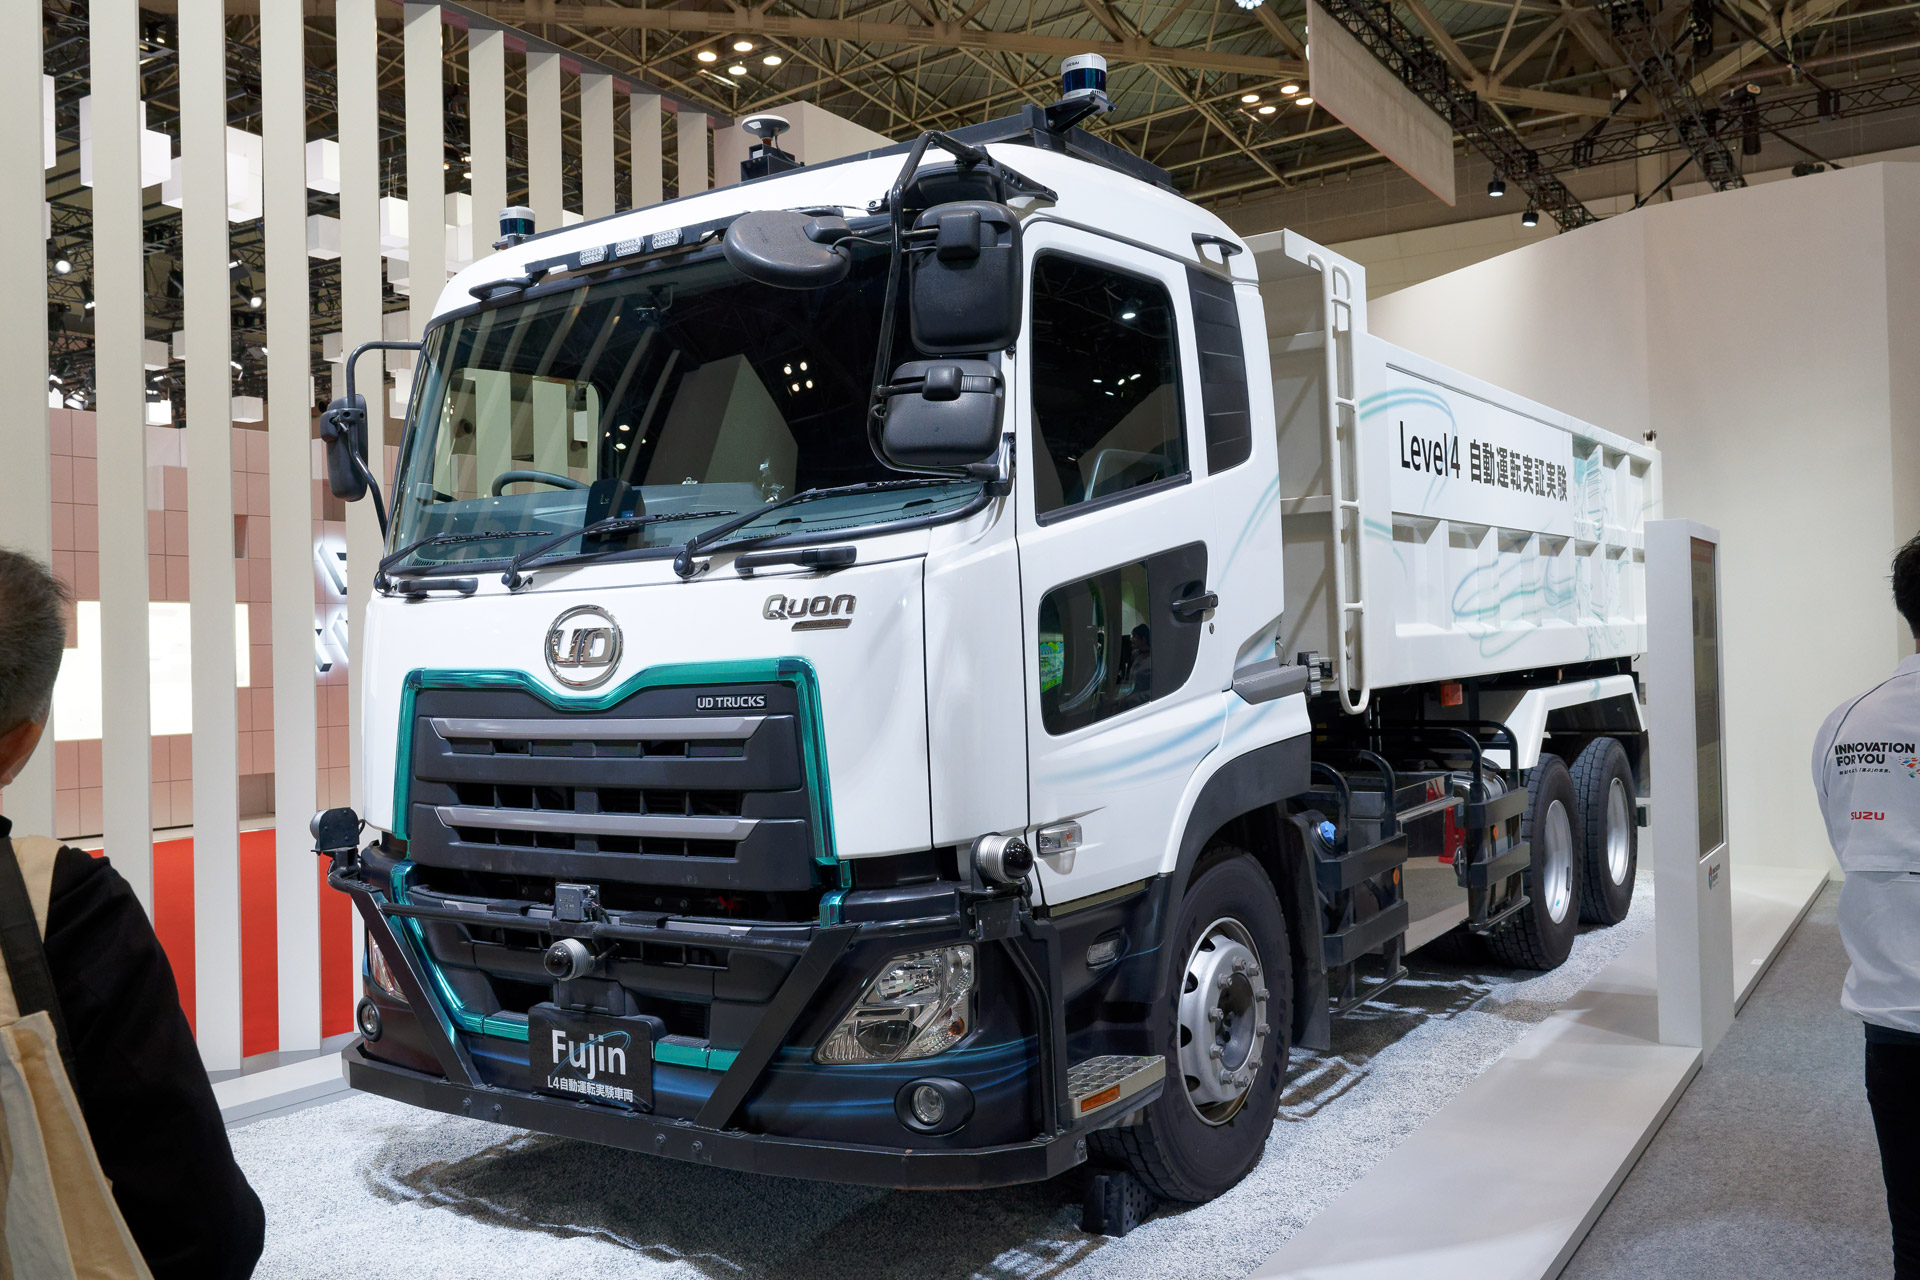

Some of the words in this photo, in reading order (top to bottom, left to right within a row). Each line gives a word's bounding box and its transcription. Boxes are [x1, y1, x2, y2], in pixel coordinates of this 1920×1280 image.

[1399, 420, 1461, 479] Level4
[1469, 439, 1568, 502] 自動運転実証実験
[762, 593, 857, 620] Quon
[551, 627, 617, 668] UD
[697, 697, 714, 709] UD
[715, 695, 765, 708] TRUCKS
[1834, 742, 1916, 755] INNOVATION
[1836, 754, 1856, 766] FOR
[1857, 753, 1885, 765] YOU
[1850, 811, 1885, 820] SUZU
[551, 1029, 627, 1080] Fujin
[547, 1075, 634, 1103] L4自動運転実験車両
